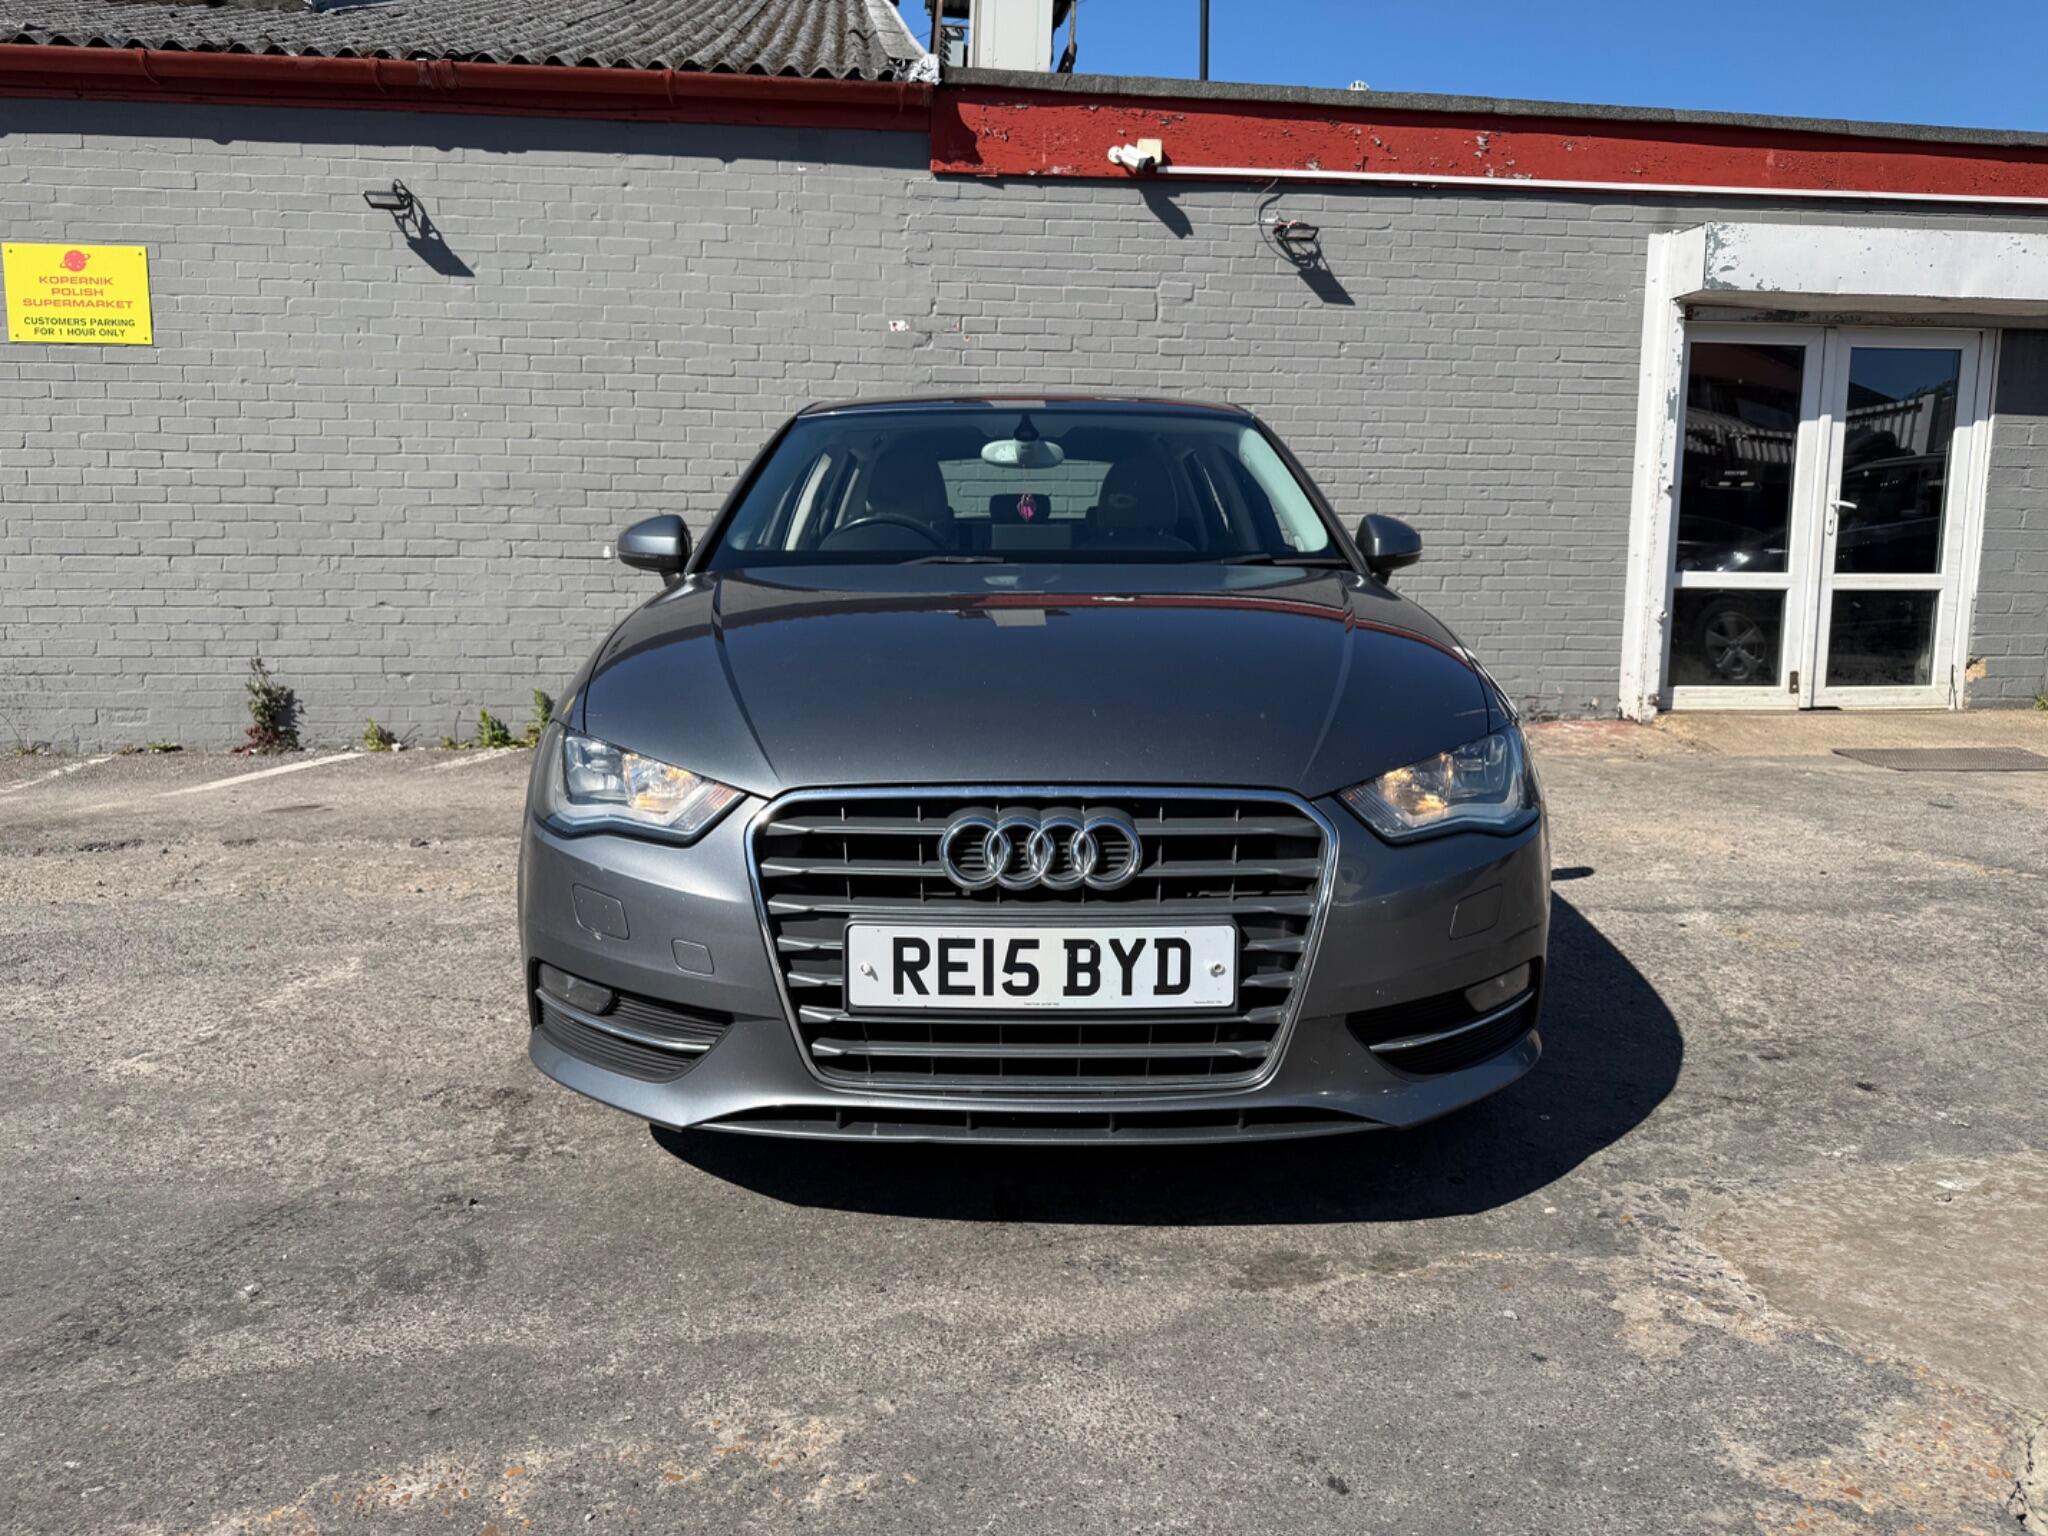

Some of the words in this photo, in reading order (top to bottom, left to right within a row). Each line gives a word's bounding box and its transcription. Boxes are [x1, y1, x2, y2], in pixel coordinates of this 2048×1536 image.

[38, 275, 114, 286] KOPERNIK
[51, 287, 104, 297] POLISH
[22, 298, 135, 309] SUPERMARKET
[23, 316, 87, 327] CUSTOMERS
[89, 318, 136, 328] PARKING
[34, 327, 55, 336] FOR
[67, 328, 96, 337] HOUR
[98, 328, 126, 338] ONLY
[892, 936, 1041, 996] RE15
[1062, 937, 1193, 997] BYD
